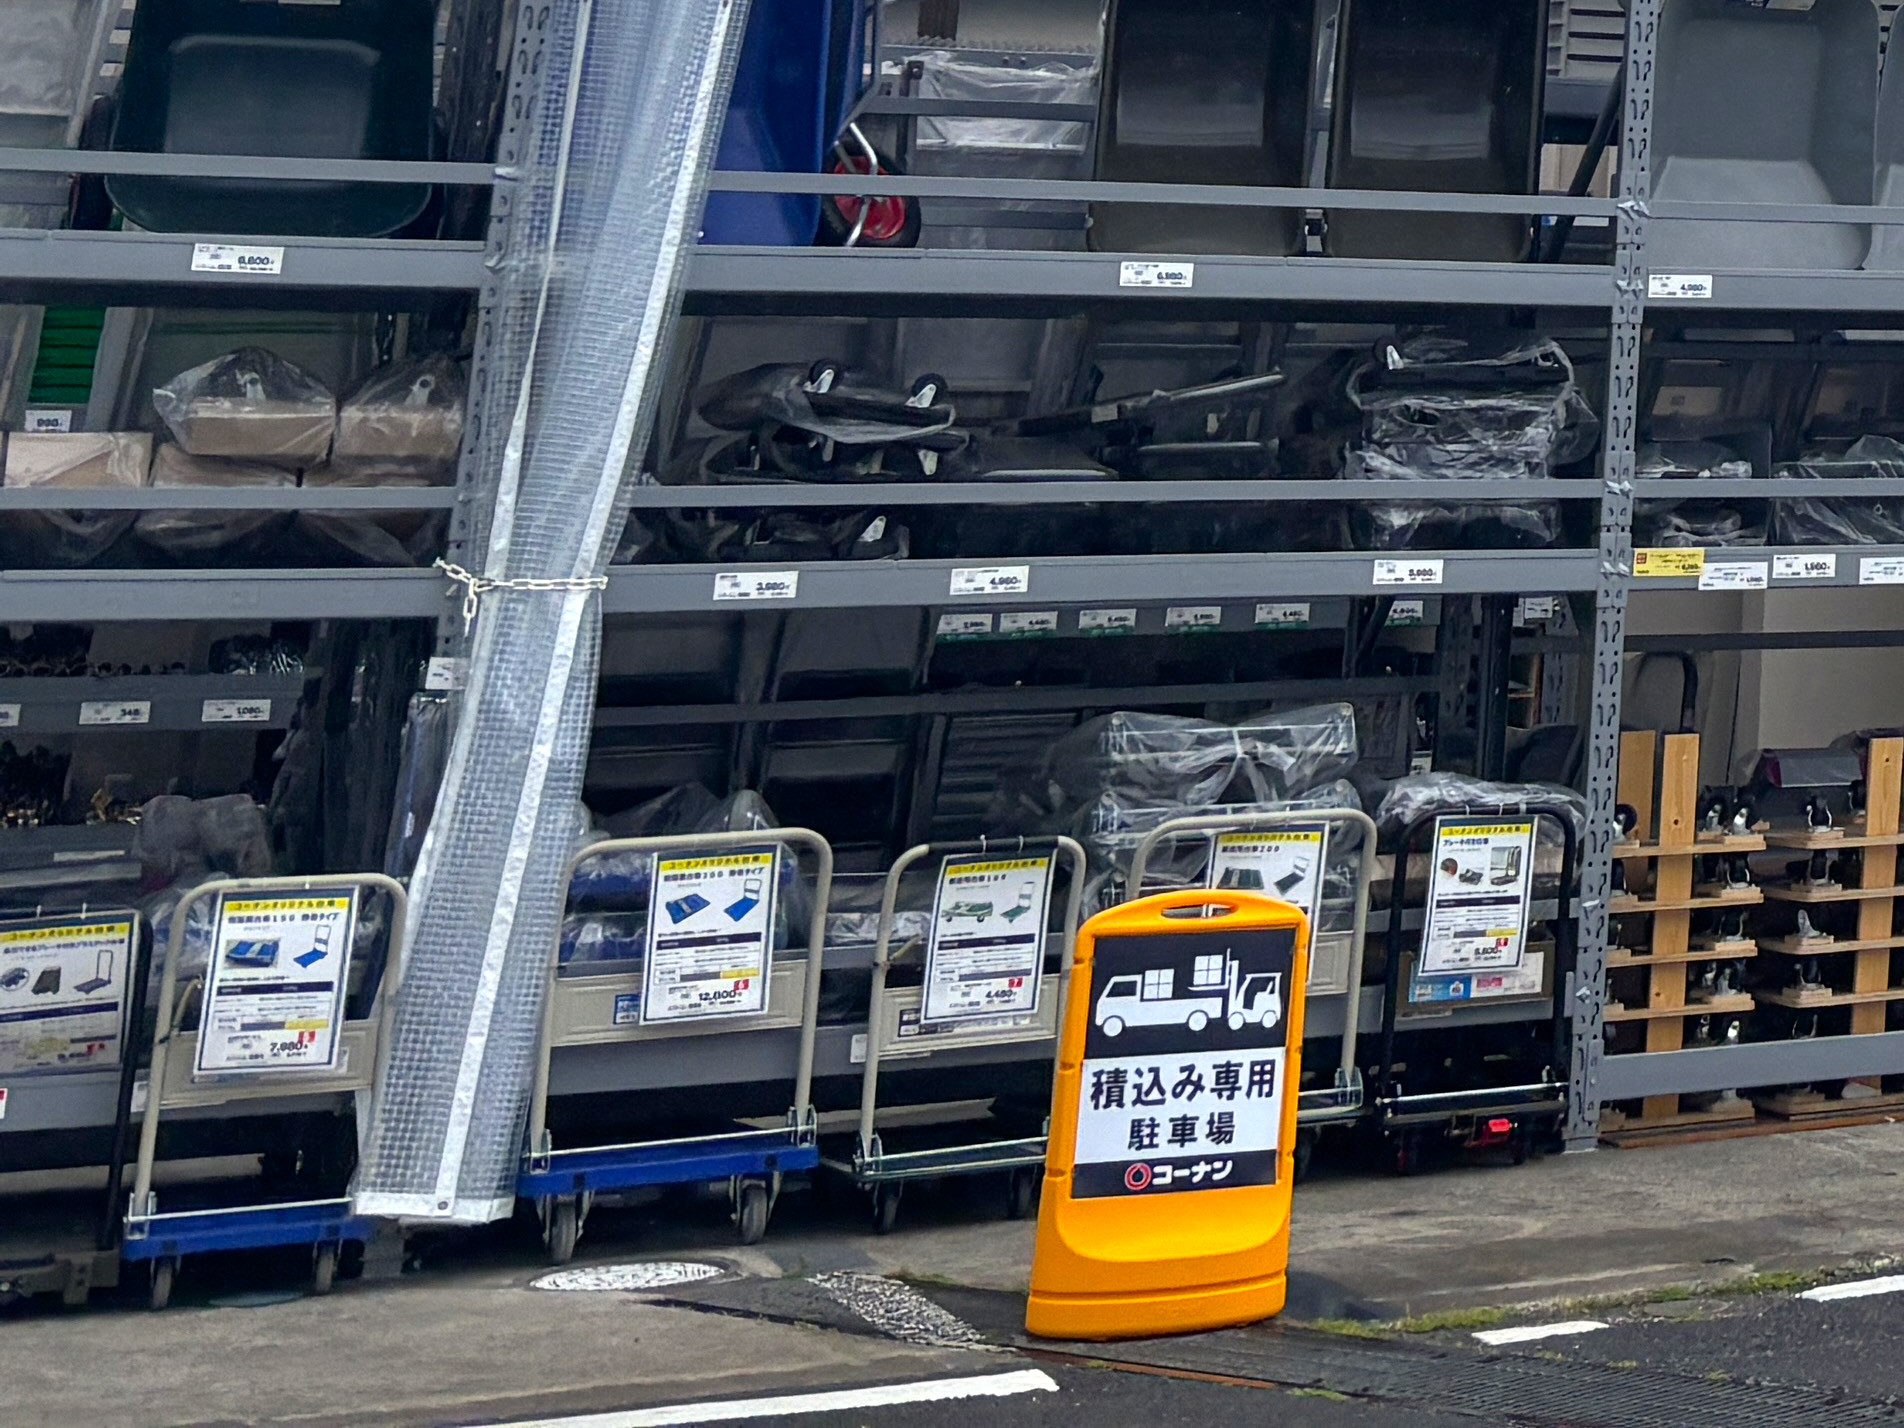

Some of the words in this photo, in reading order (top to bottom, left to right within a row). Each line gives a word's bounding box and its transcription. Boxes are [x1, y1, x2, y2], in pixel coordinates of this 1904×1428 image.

[1090, 1059, 1276, 1110] 積込み専用
[1127, 1111, 1236, 1151] 駐車場
[1152, 1160, 1233, 1185] コーナン
